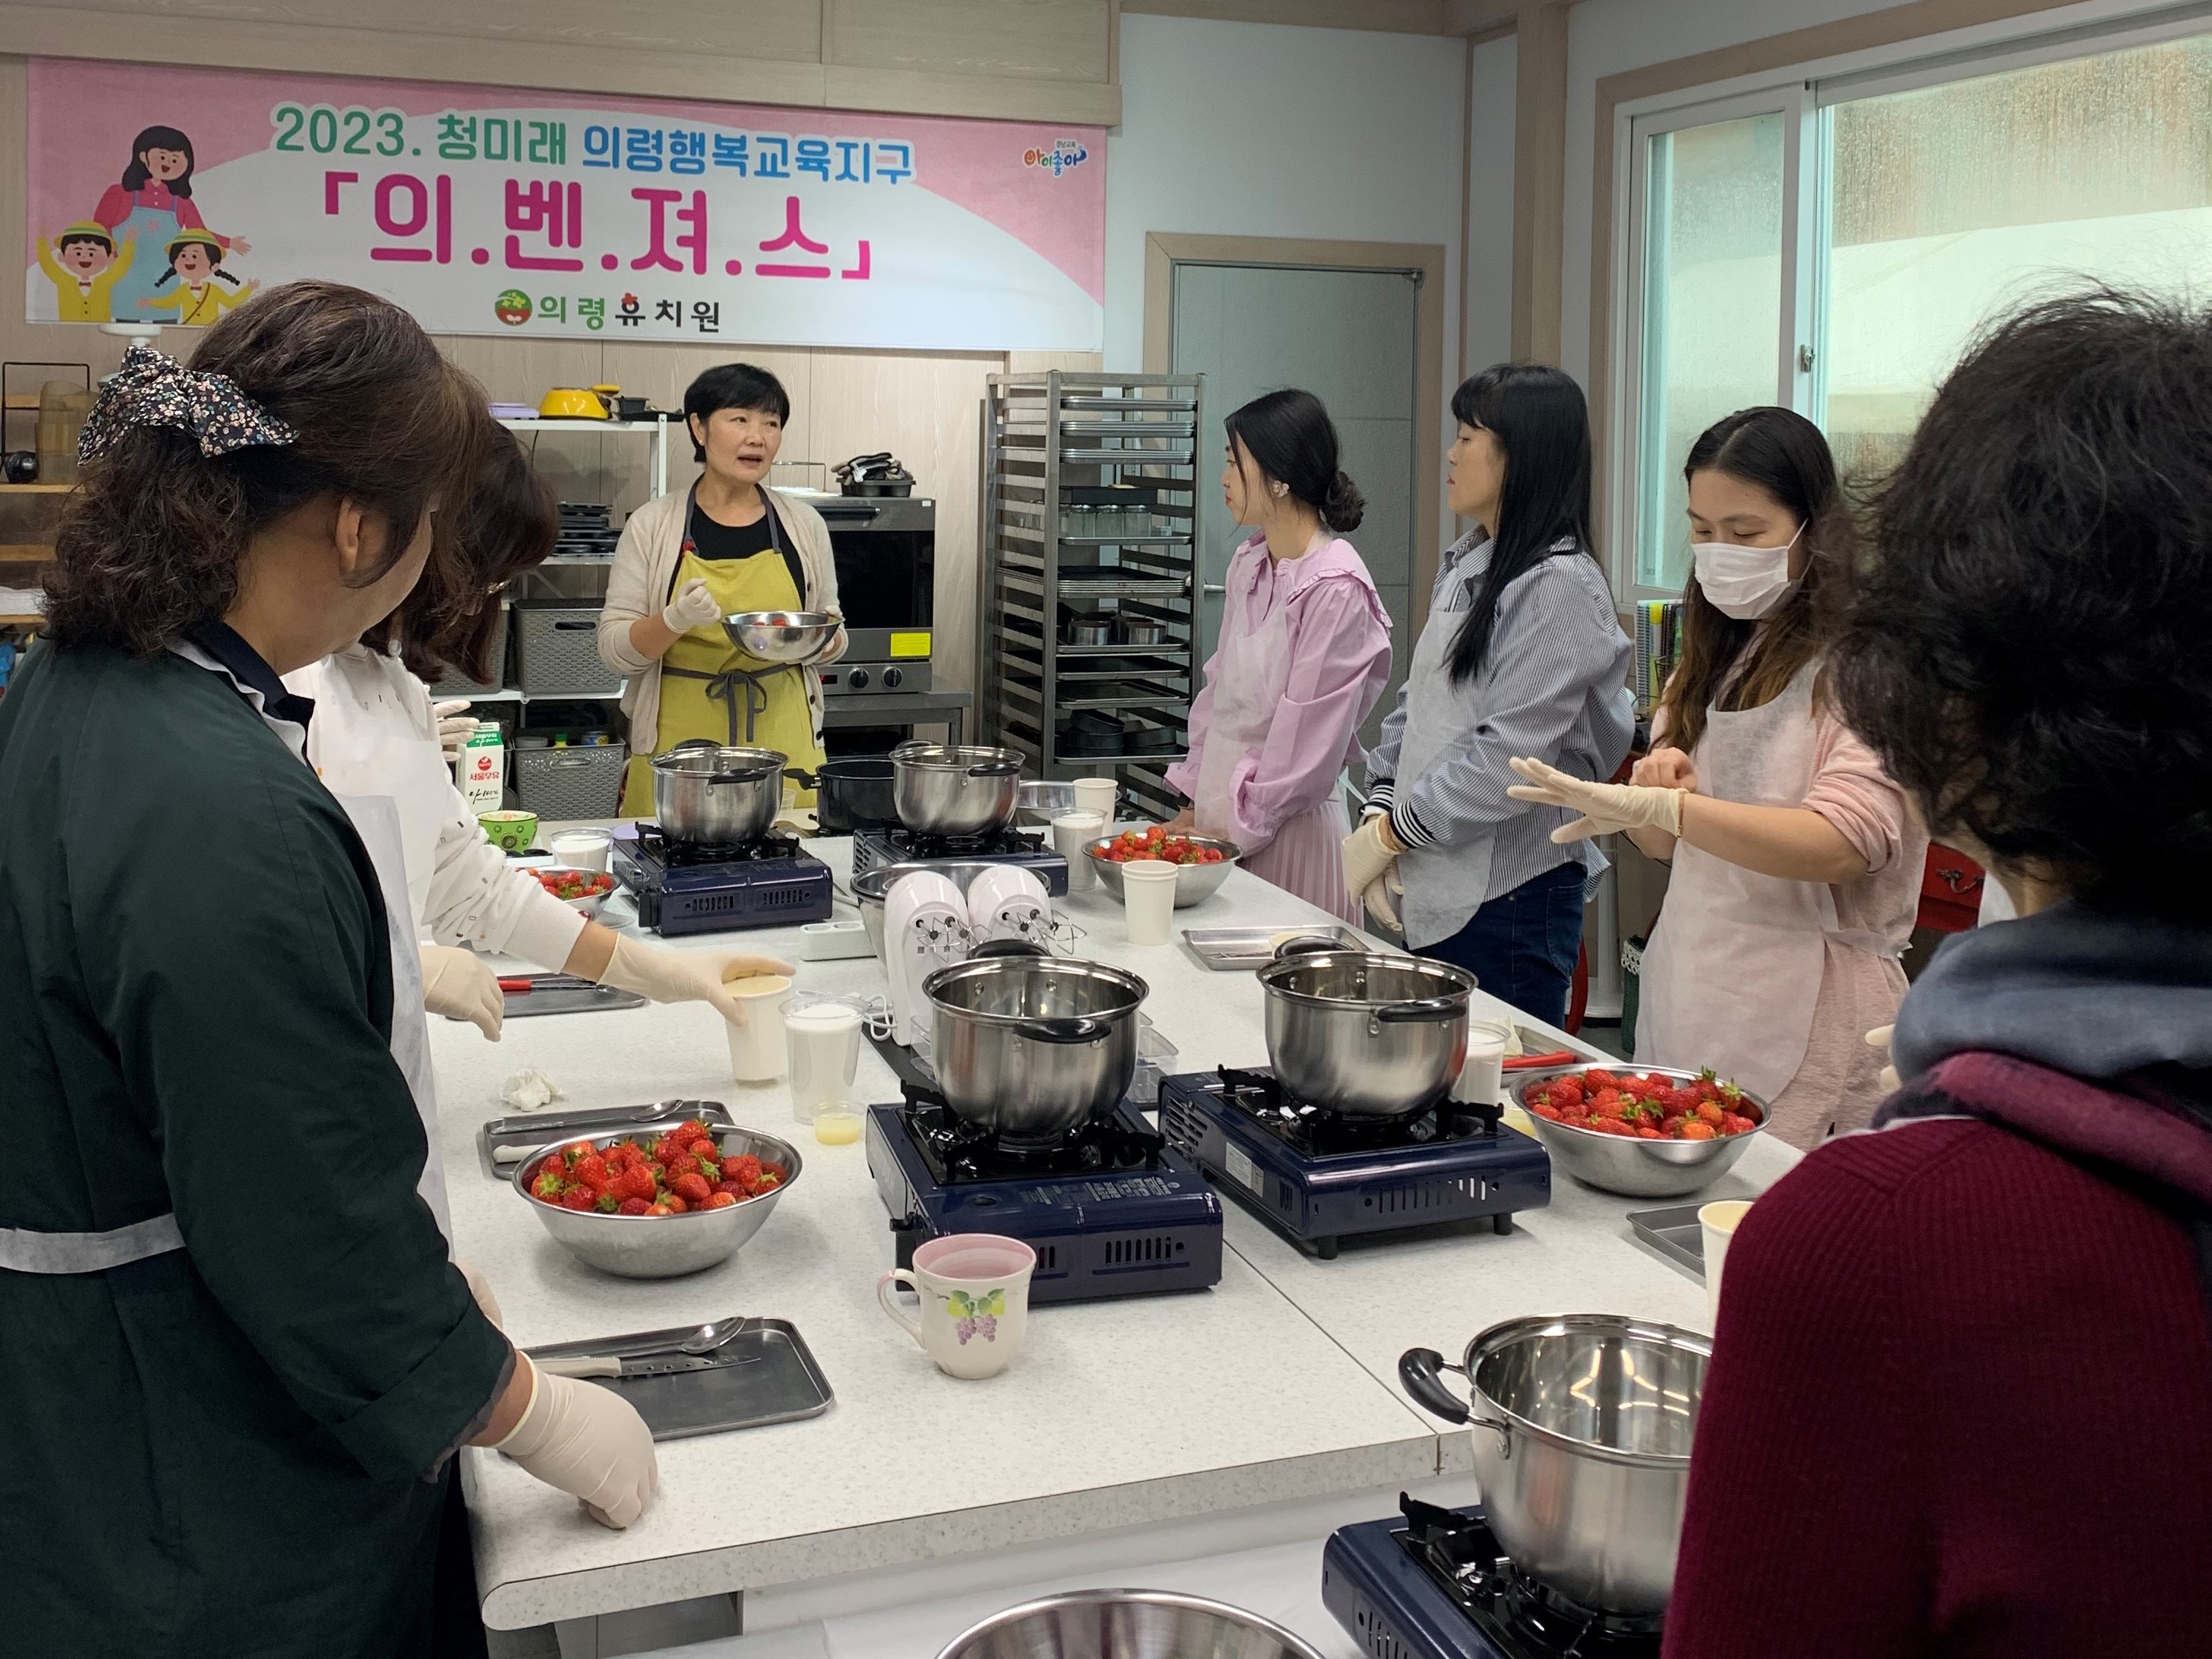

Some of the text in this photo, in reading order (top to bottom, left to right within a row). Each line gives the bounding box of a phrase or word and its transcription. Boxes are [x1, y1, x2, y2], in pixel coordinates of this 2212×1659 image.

[276, 107, 913, 185] 2023. 청미래 의령행복교육지구
[1024, 148, 1087, 176] 아이좋아
[469, 772, 500, 781] 서울우유
